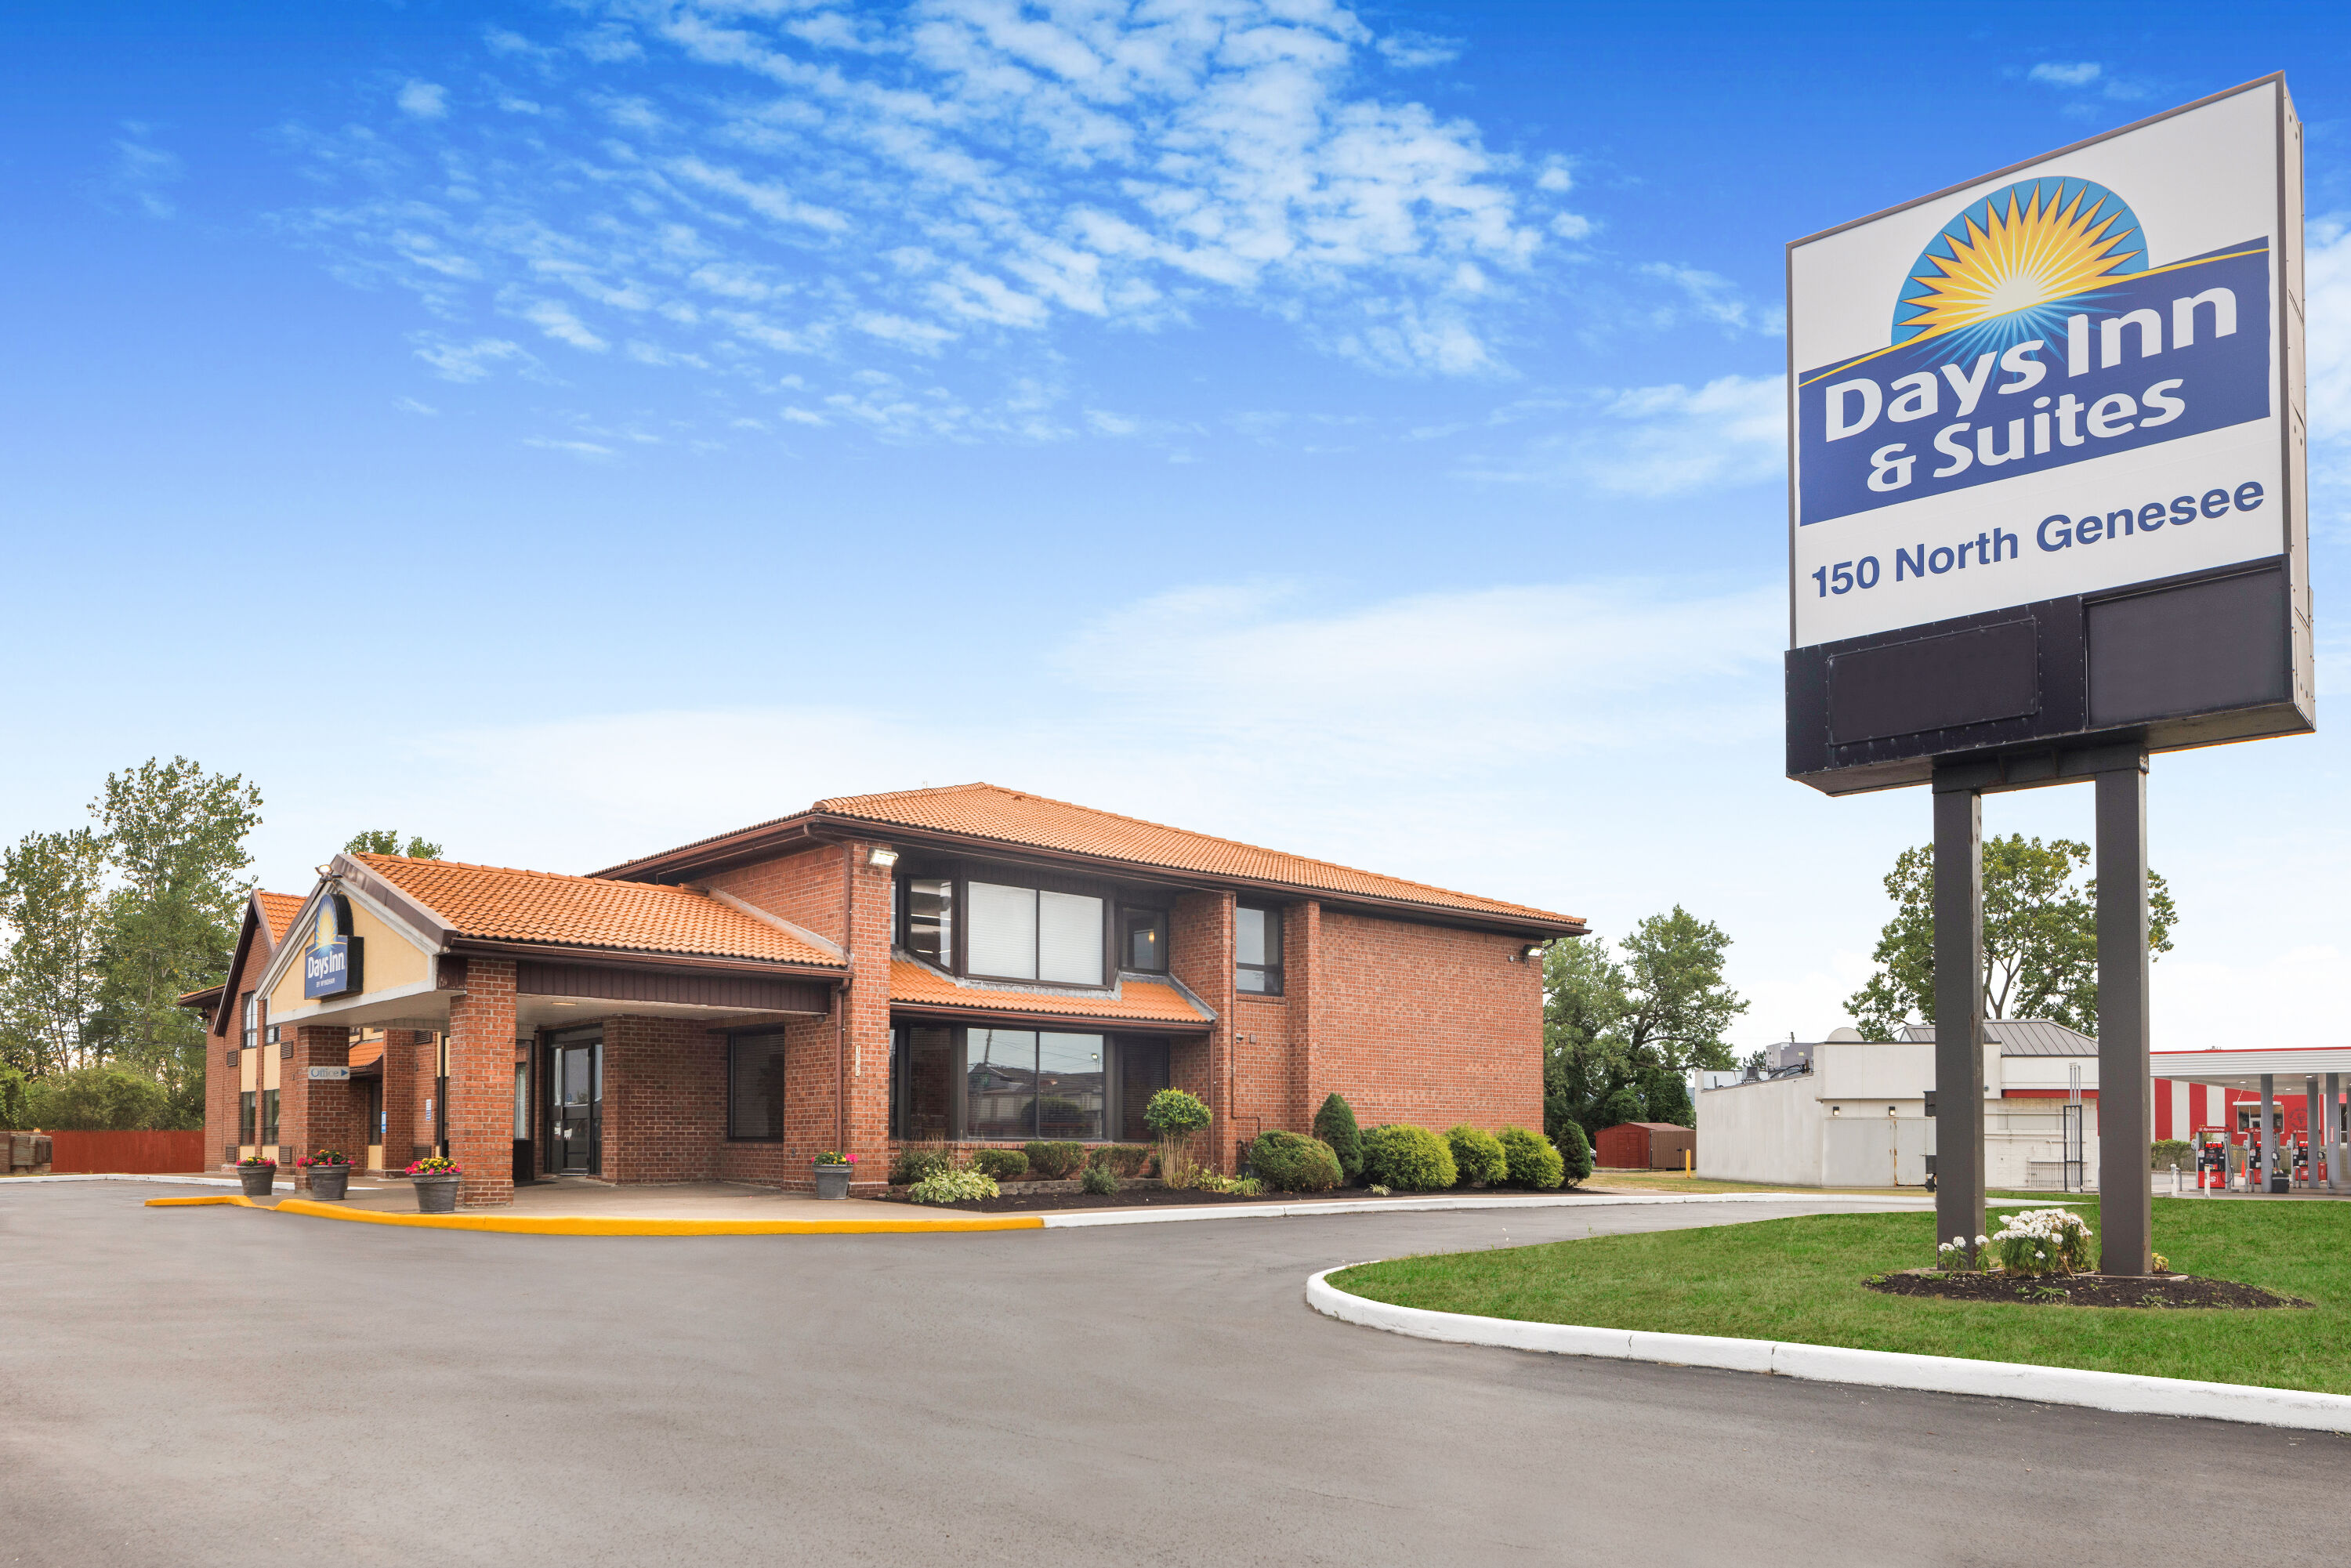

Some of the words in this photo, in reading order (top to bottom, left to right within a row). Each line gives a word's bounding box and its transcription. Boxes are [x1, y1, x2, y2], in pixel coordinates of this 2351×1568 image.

[1825, 339, 2046, 444] Days
[2067, 287, 2237, 378] Inn
[1867, 443, 1917, 493] &
[1933, 378, 2186, 478] Suites
[1812, 556, 1880, 598] 150
[1896, 527, 2018, 581] North
[2037, 481, 2264, 552] Genesee
[308, 957, 328, 979] Days
[329, 951, 345, 972] Inn
[310, 1068, 339, 1077] Office
